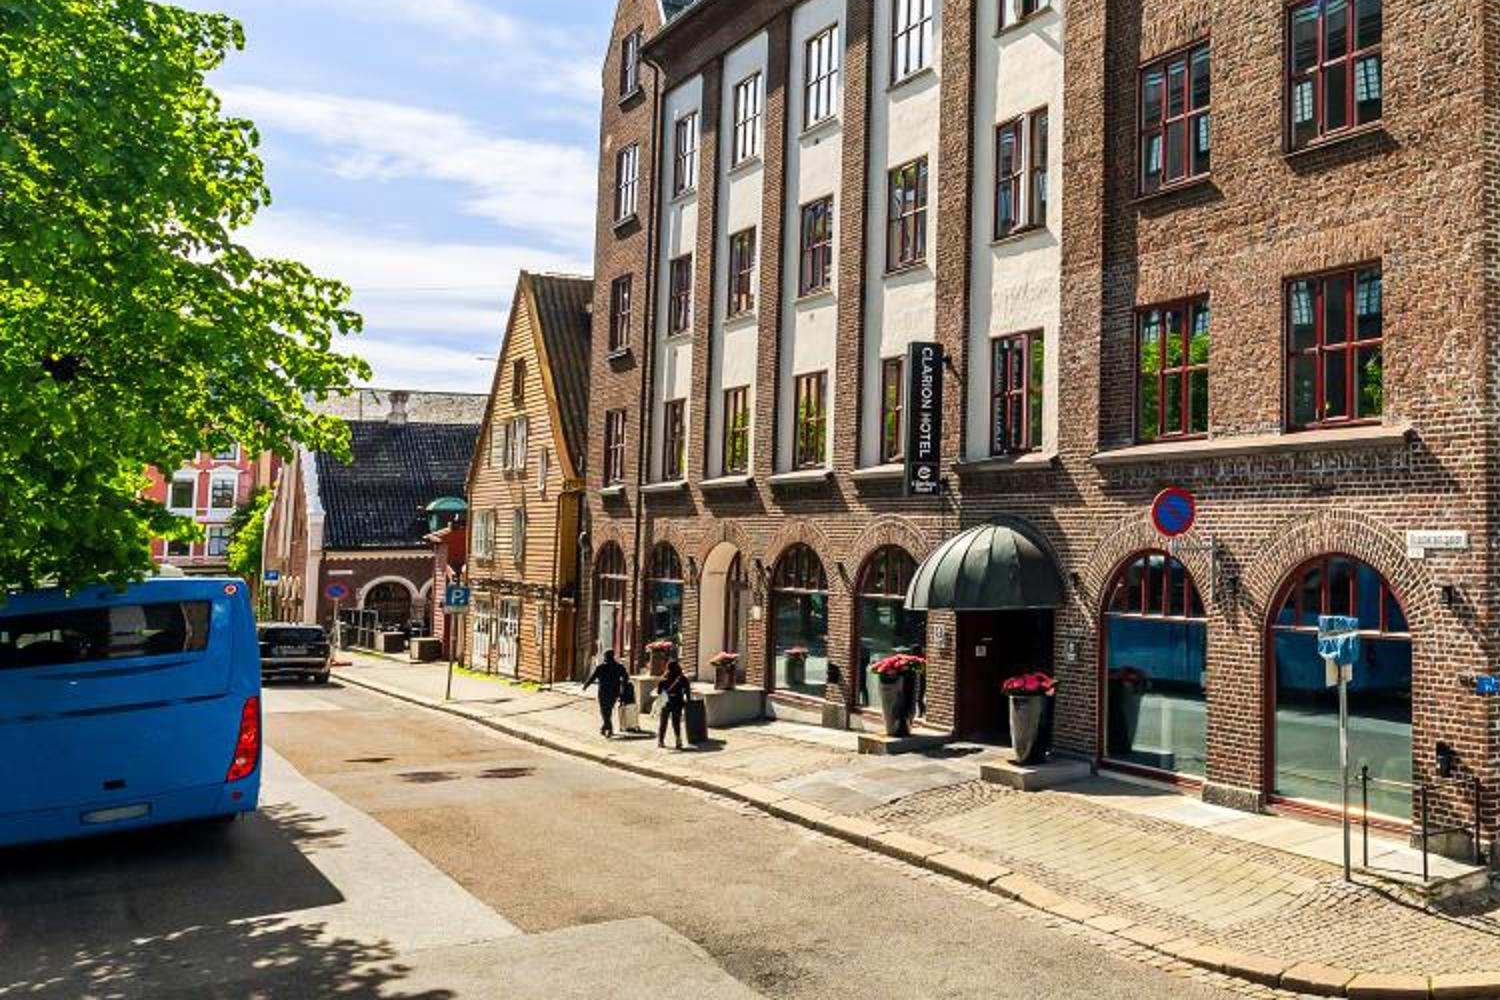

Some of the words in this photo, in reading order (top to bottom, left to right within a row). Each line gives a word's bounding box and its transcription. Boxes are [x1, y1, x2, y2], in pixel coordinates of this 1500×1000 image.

[921, 346, 933, 409] CLARION
[919, 412, 932, 458] HOTEL
[451, 589, 464, 604] P
